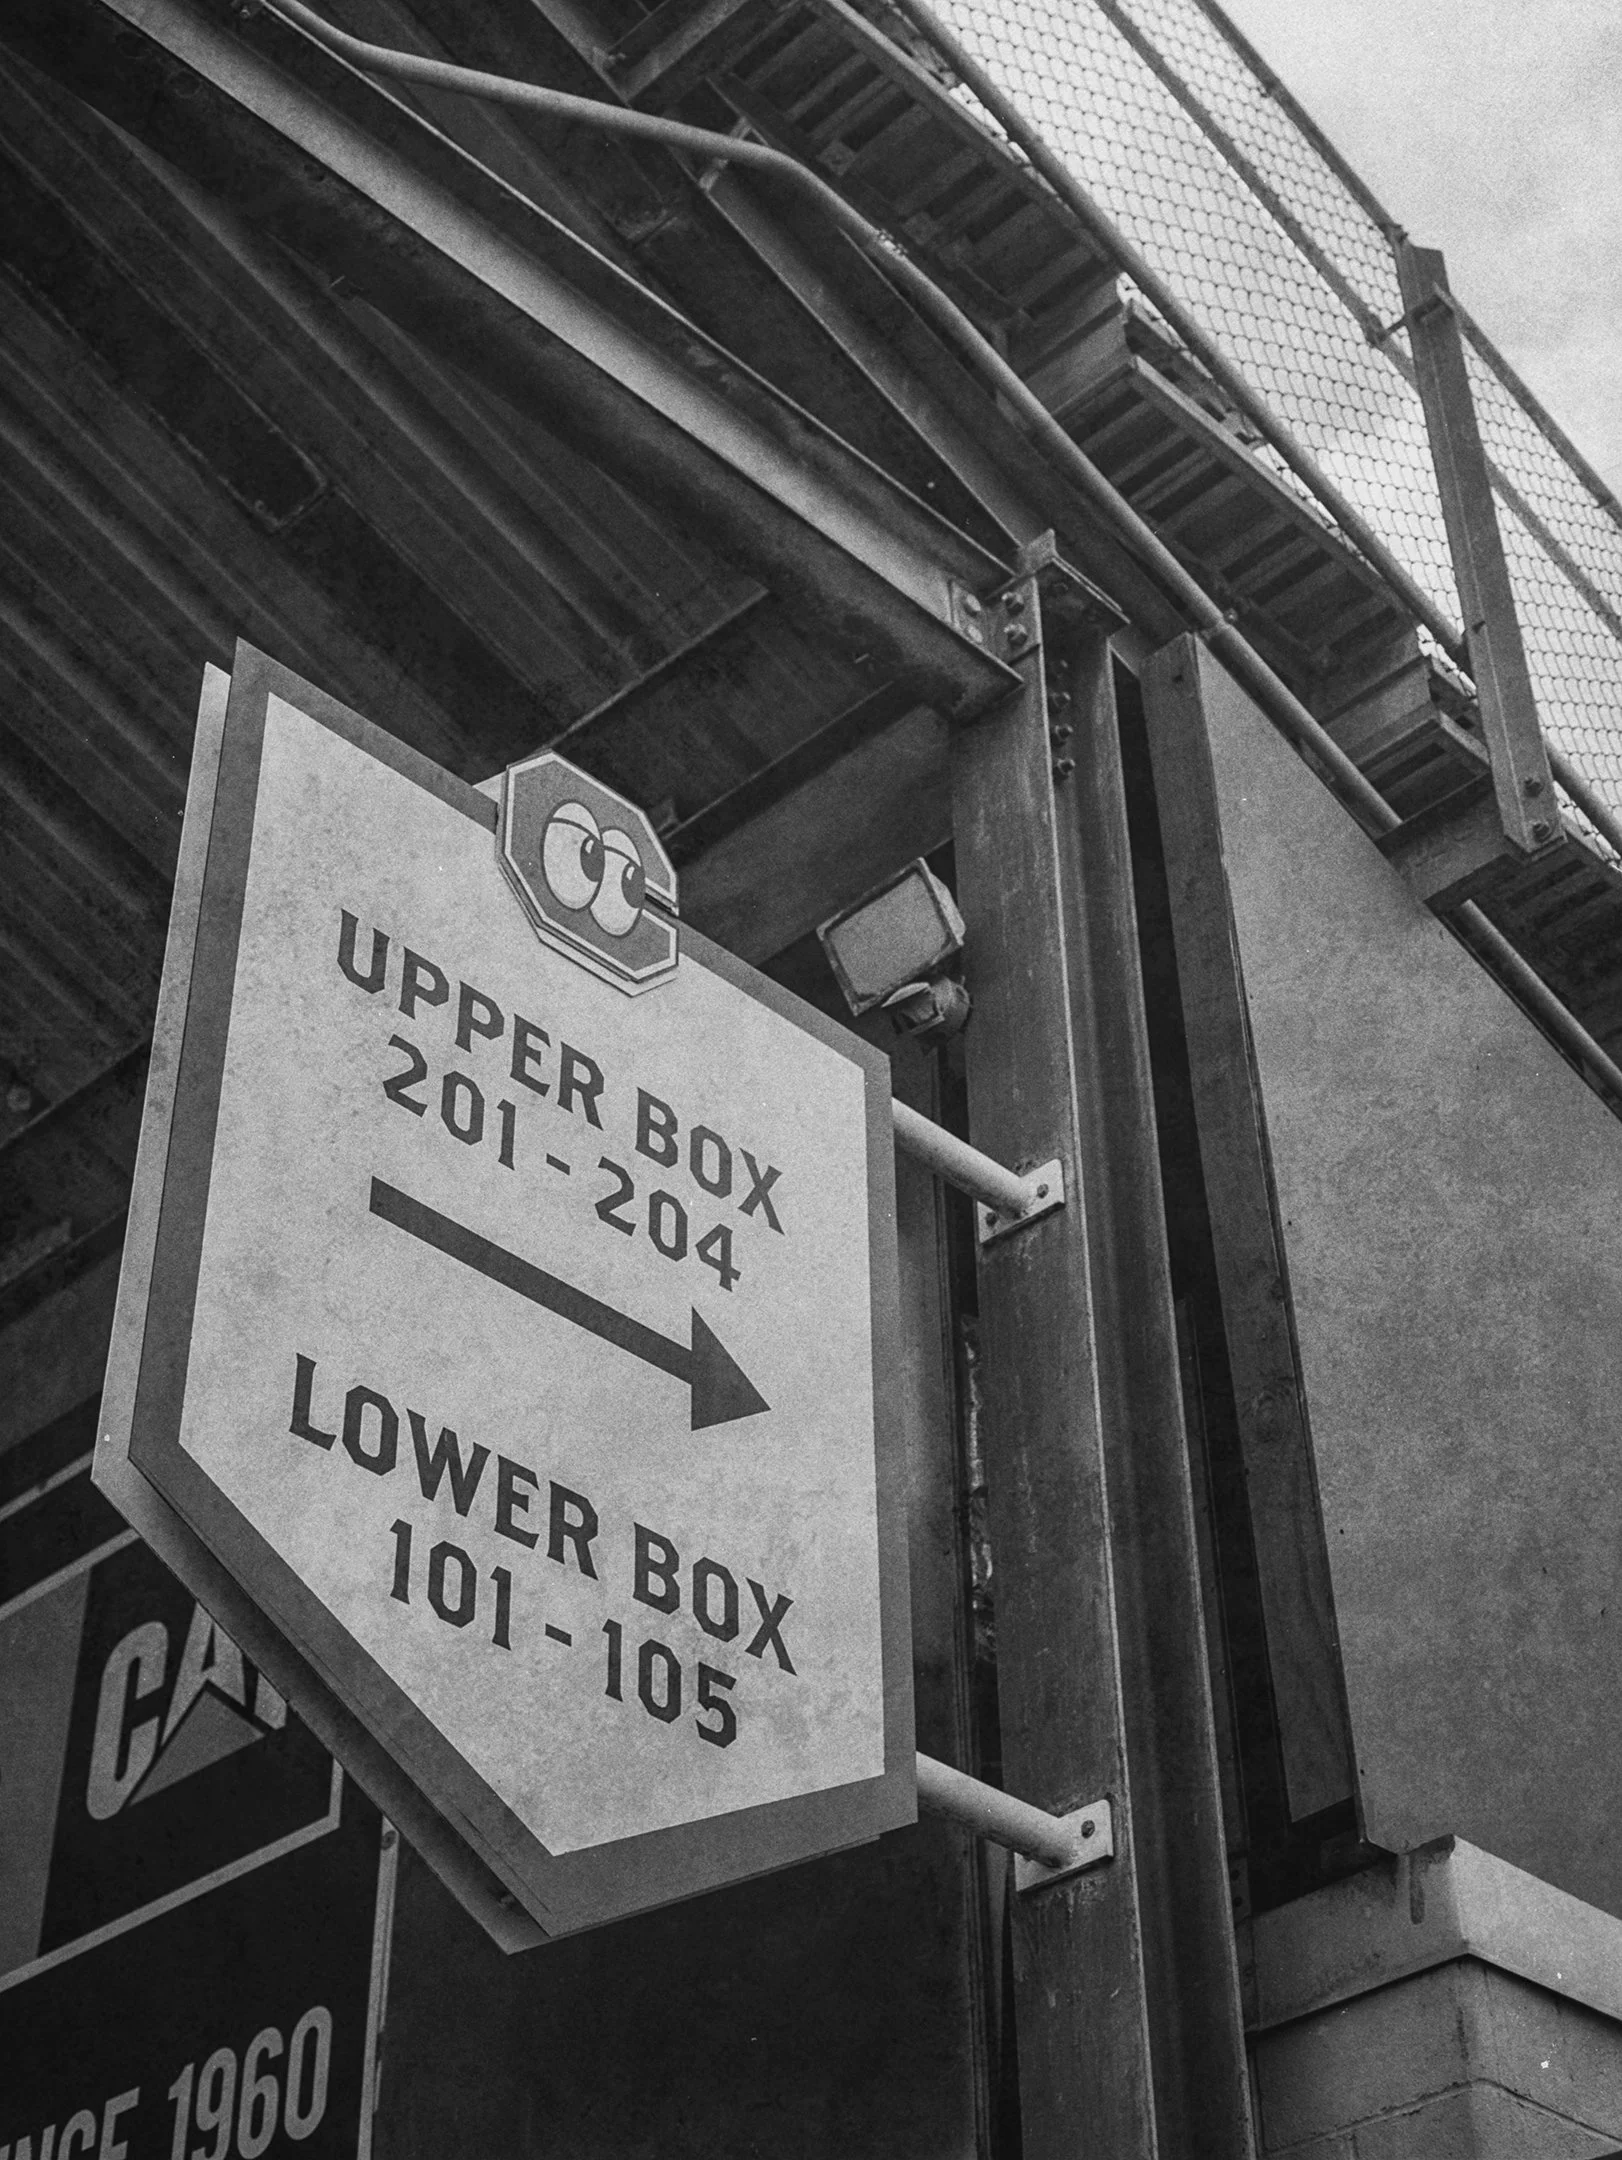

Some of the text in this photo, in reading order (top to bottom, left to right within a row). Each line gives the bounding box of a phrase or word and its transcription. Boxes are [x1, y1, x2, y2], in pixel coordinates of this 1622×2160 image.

[337, 909, 783, 1233] UPPER BOX
[289, 1353, 796, 1675] LOWER BOX
[167, 2005, 333, 2160] 1960
